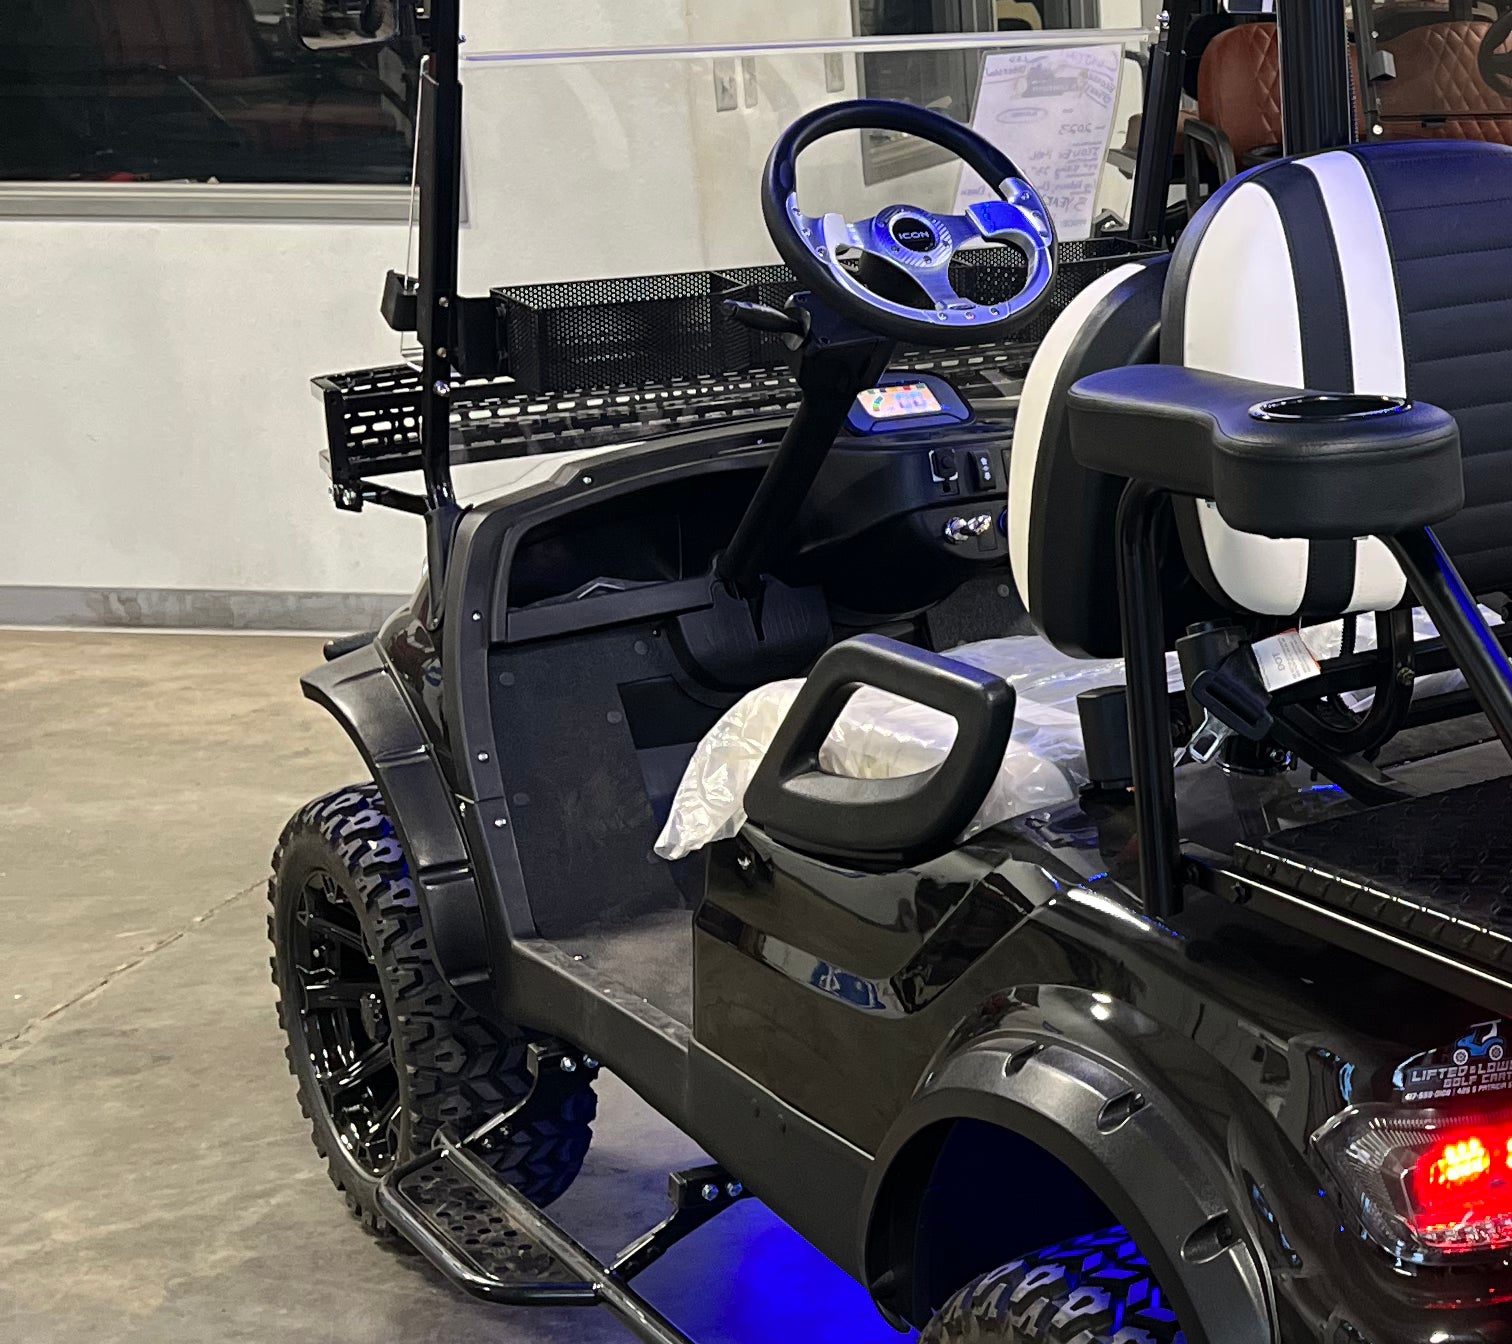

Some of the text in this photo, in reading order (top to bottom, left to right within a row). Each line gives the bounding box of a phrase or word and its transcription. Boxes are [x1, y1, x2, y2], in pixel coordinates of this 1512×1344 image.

[898, 230, 930, 240] ICON
[1411, 1065, 1469, 1082] LIFTED
[1442, 1075, 1477, 1088] GOLF
